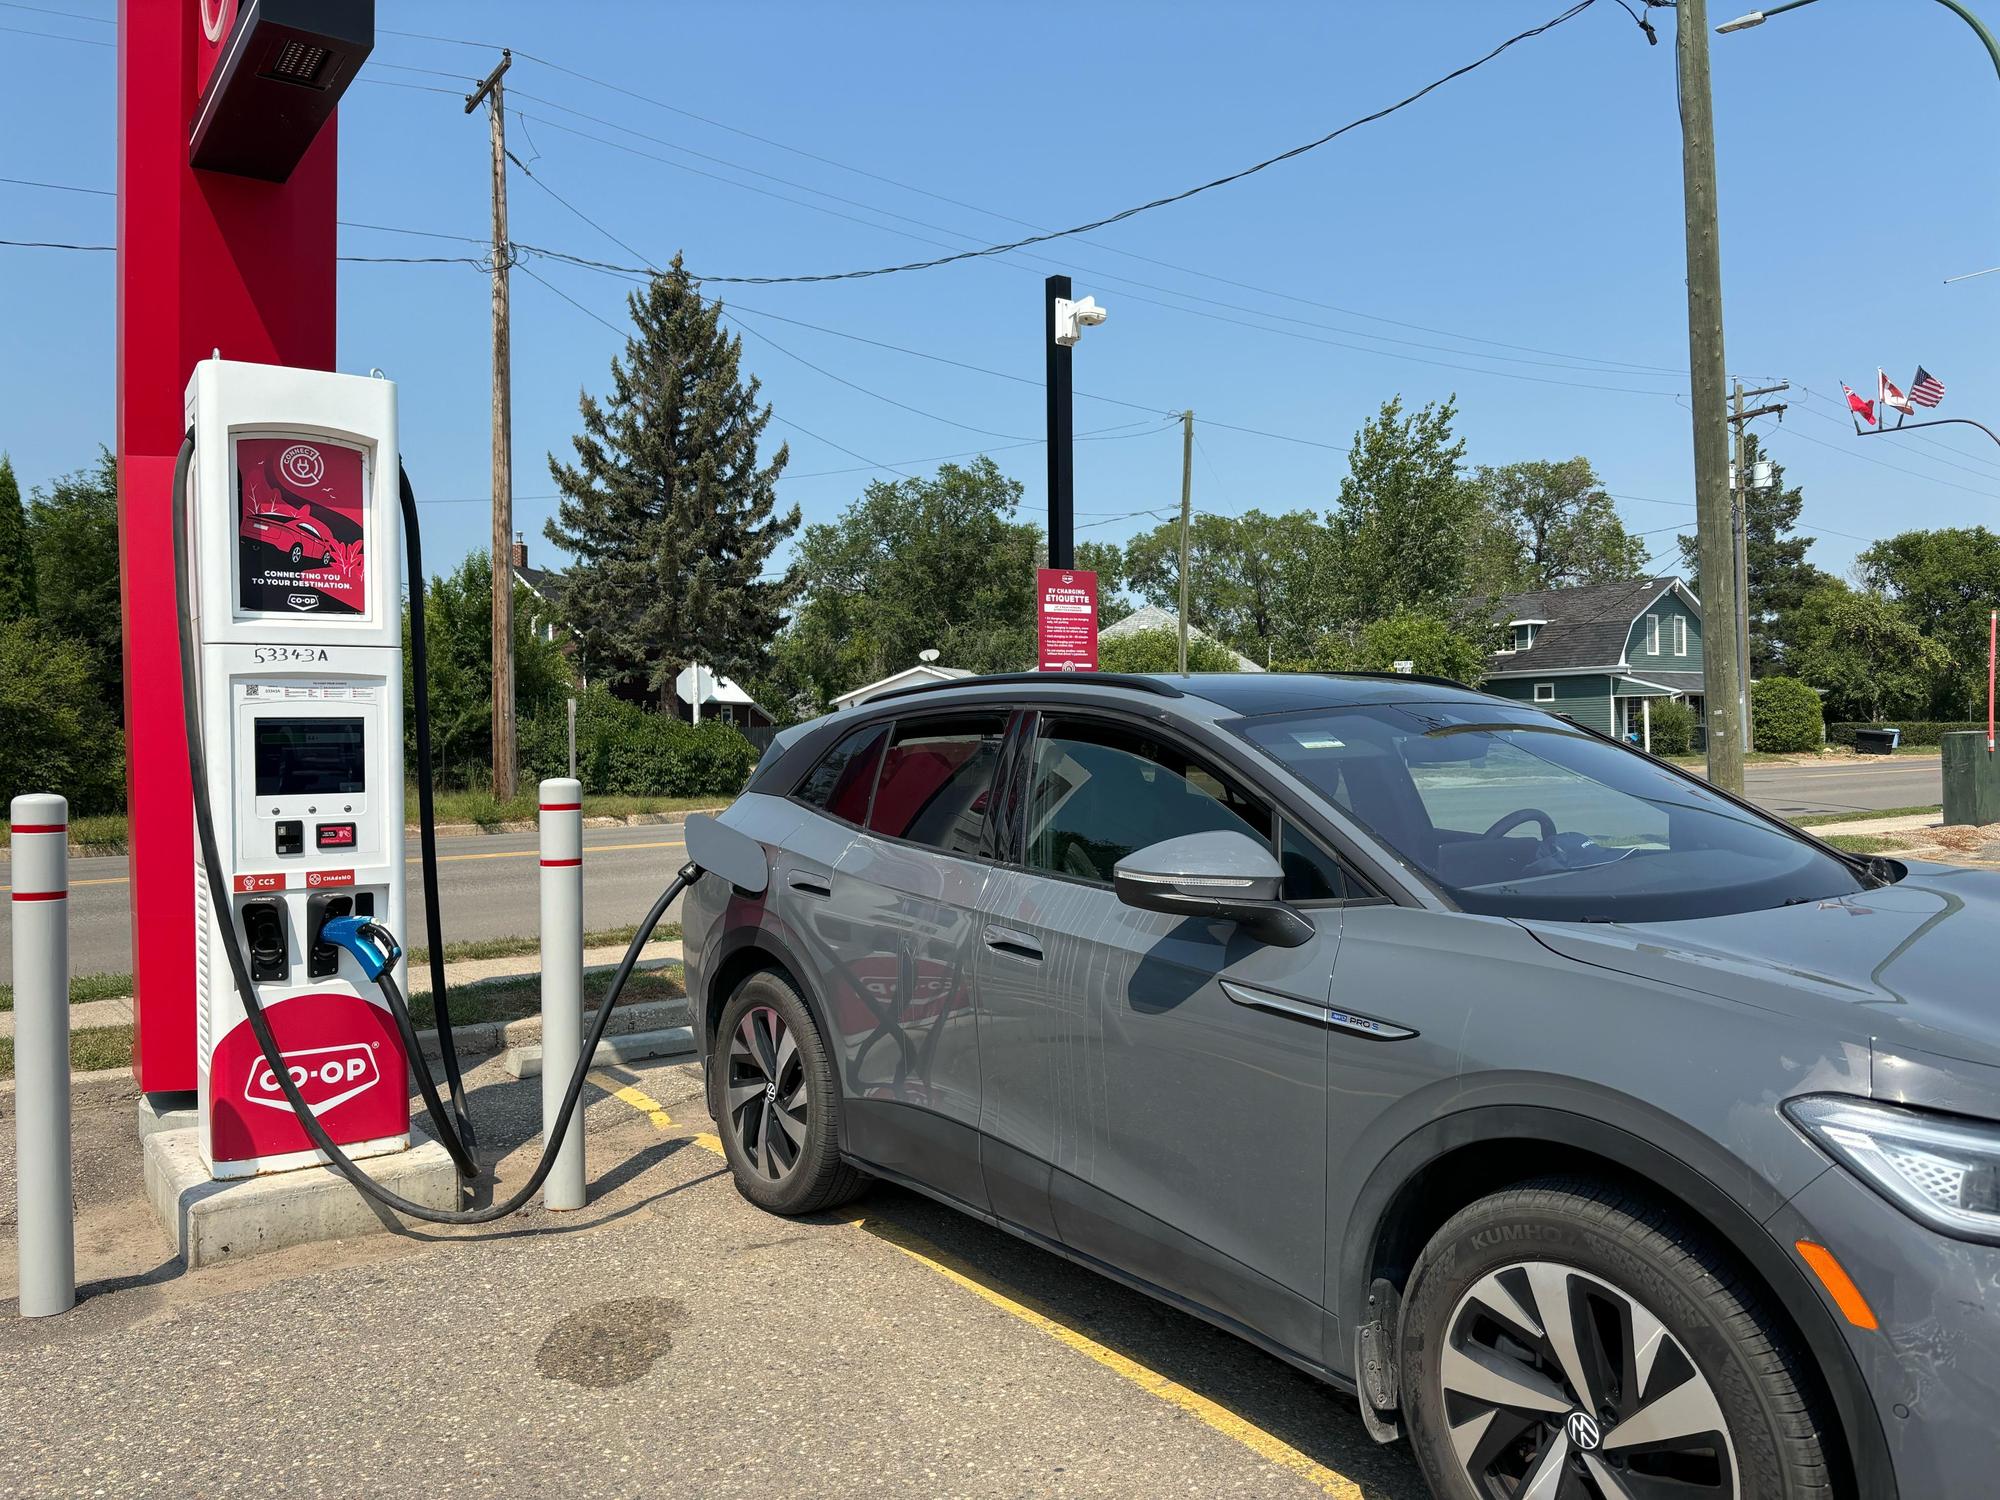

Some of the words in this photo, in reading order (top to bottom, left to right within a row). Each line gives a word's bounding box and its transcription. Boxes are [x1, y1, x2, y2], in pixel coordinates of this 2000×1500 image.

[284, 448, 315, 464] CONNECT
[264, 570, 321, 580] CONNECTING
[323, 573, 340, 581] YOU
[252, 577, 265, 585] TO
[267, 578, 291, 587] YOUR
[292, 580, 353, 590] DESTINATION.
[290, 597, 316, 605] CO-OP
[1045, 594, 1090, 604] ETIQUETTE
[253, 647, 329, 664] 53343A
[258, 878, 275, 886] CCS
[323, 873, 352, 882] CHAdeMO
[1349, 1017, 1371, 1028] PRO
[259, 1058, 366, 1091] CO-OP
[1471, 1224, 1562, 1250] KUMHO
